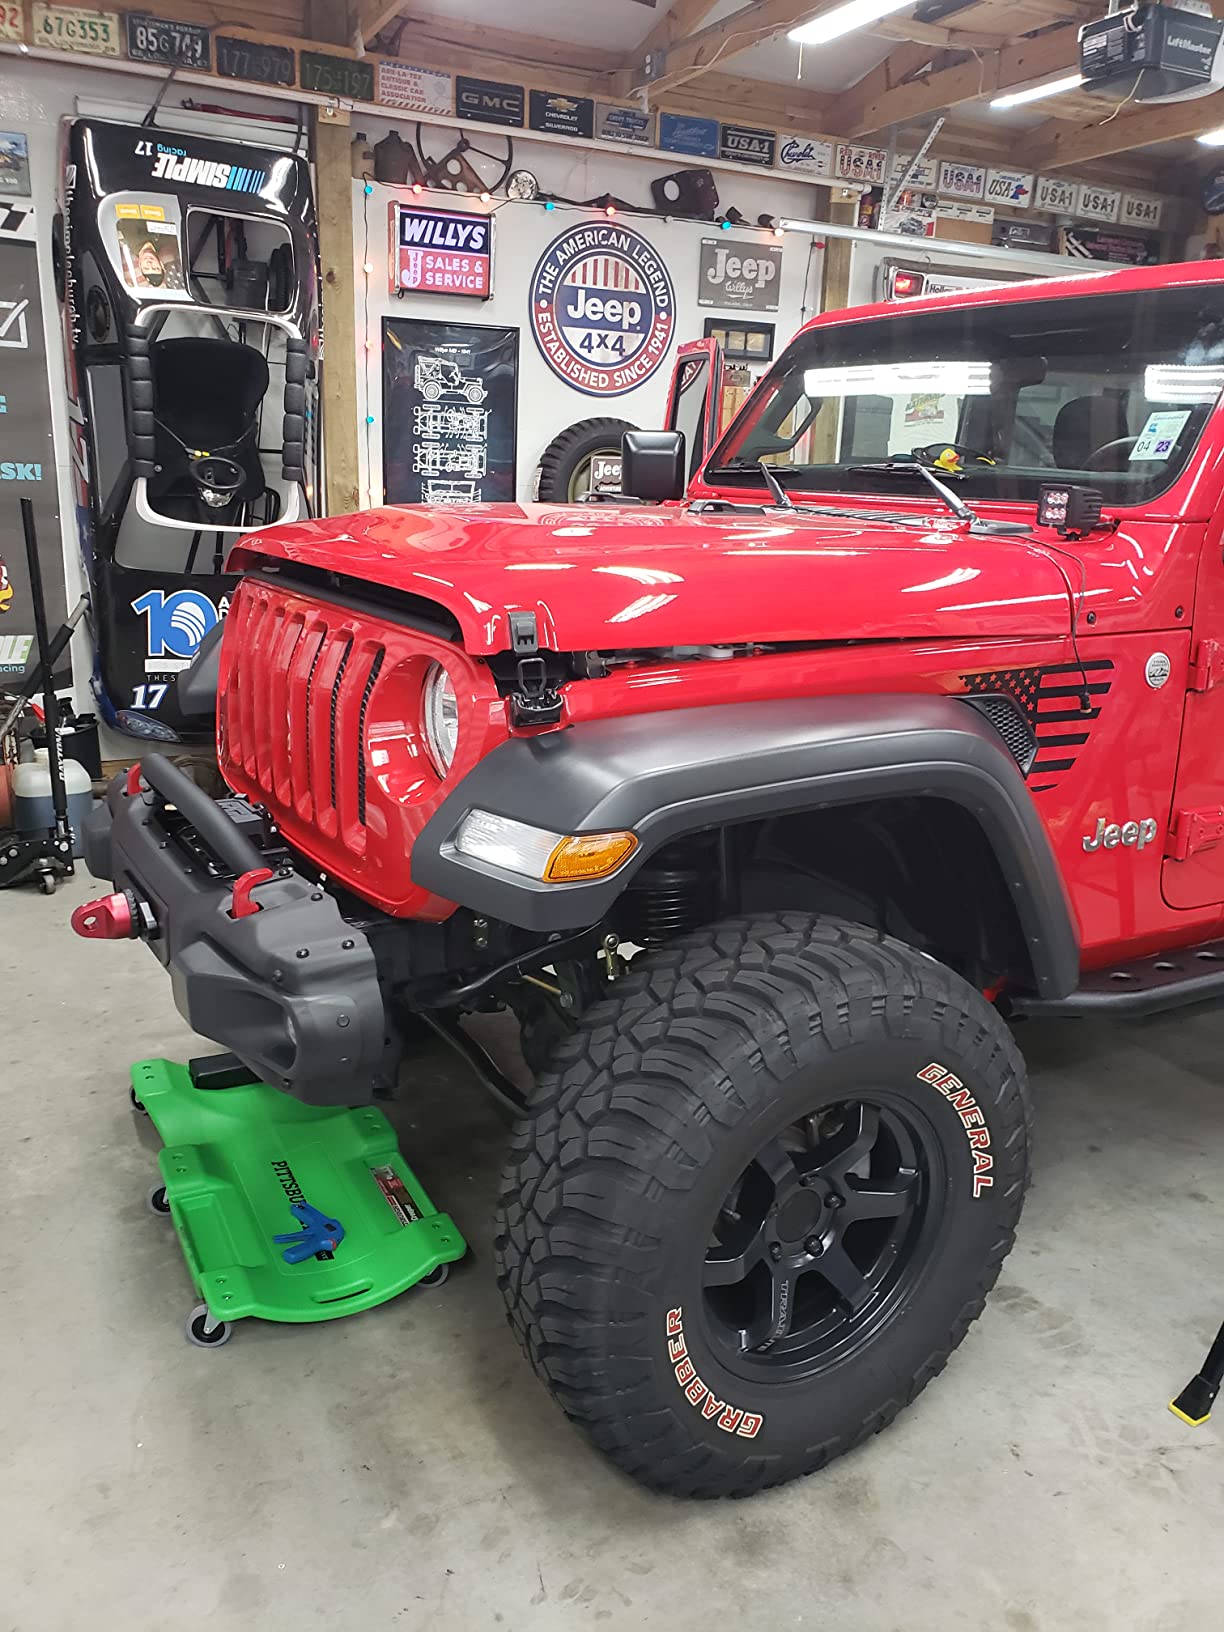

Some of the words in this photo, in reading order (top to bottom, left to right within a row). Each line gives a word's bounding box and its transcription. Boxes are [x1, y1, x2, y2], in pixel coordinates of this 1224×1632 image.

[43, 16, 110, 42] 67G353
[1167, 35, 1212, 54] LiftMaster
[462, 92, 520, 112] GMC
[545, 111, 578, 121] CHEVROLET
[545, 122, 578, 132] SILVERADO
[134, 141, 153, 155] 17
[157, 143, 187, 156] racing
[152, 152, 231, 189] SIMPLE
[405, 217, 486, 249] WILLYS
[426, 256, 470, 272] SALES
[474, 261, 483, 273] &
[539, 262, 560, 294] THE
[555, 229, 631, 265] AMERICAN
[632, 244, 669, 308] LEGEND
[707, 248, 776, 288] Jeep
[426, 272, 483, 289] SERVICE
[725, 281, 753, 299] Willys
[567, 288, 642, 330] Jeep
[538, 312, 609, 388] ESTABLISHED
[613, 355, 653, 387] SINCE
[648, 323, 669, 356] 1941
[1136, 441, 1151, 452] 04
[1155, 441, 1171, 452] 23
[0, 462, 42, 481] SK!
[0, 664, 25, 674] cing
[130, 684, 169, 710] 17
[1082, 817, 1157, 852] Jeep
[916, 1062, 994, 1198] GENERAL
[271, 1160, 308, 1210] PITTSBU
[666, 1306, 763, 1438] GRABBER
